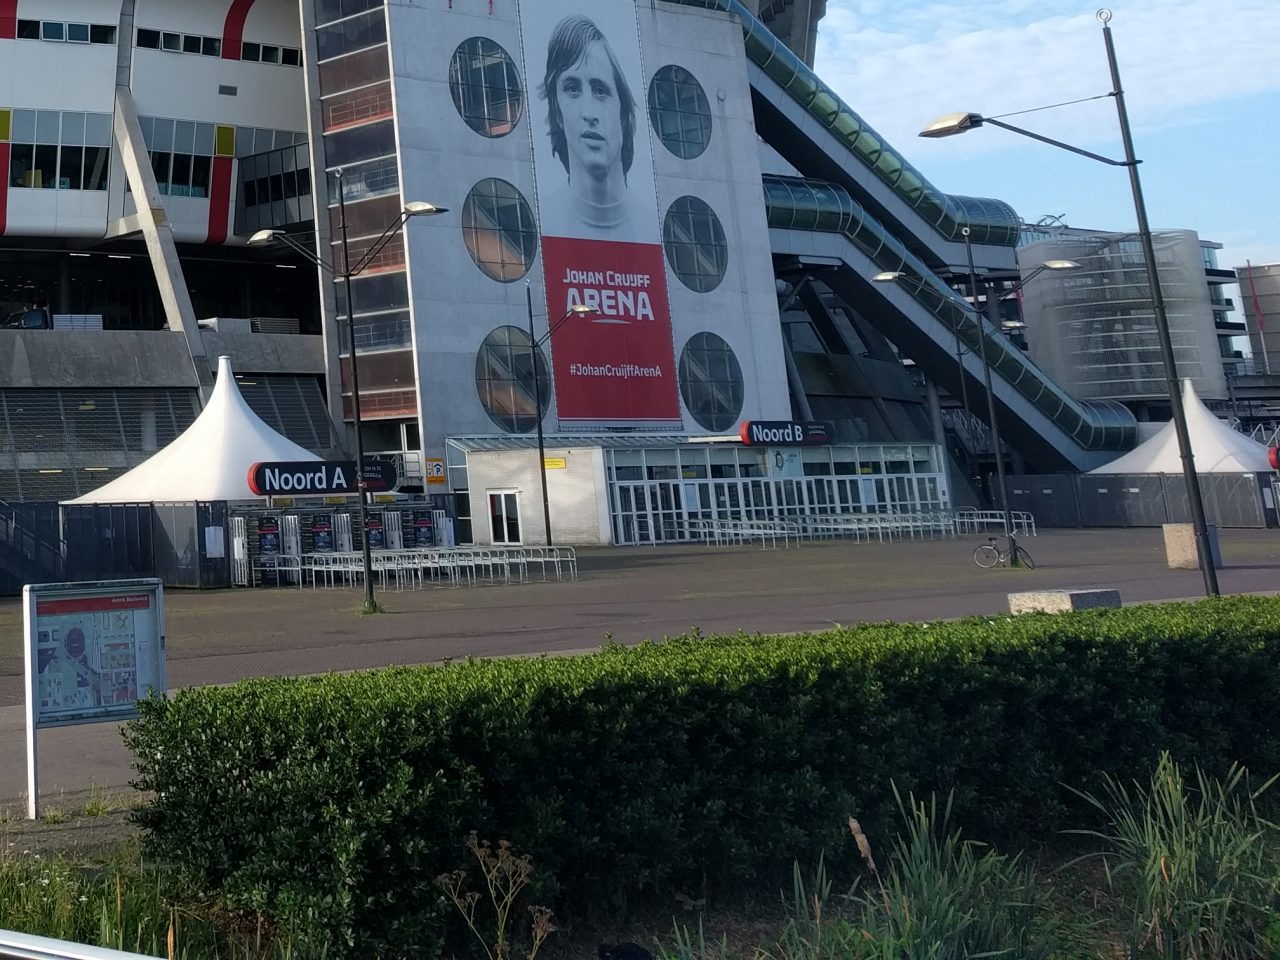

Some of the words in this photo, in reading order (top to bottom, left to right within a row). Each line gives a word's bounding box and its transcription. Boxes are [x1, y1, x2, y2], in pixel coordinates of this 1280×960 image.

[562, 268, 604, 285] JOHAN
[606, 271, 651, 287] CRUIJFF
[566, 287, 655, 321] ARENA
[569, 363, 662, 380] #JohanCruijffArenA
[752, 424, 793, 442] Noord
[794, 425, 803, 442] B
[264, 465, 327, 491] Noord
[332, 466, 348, 489] A
